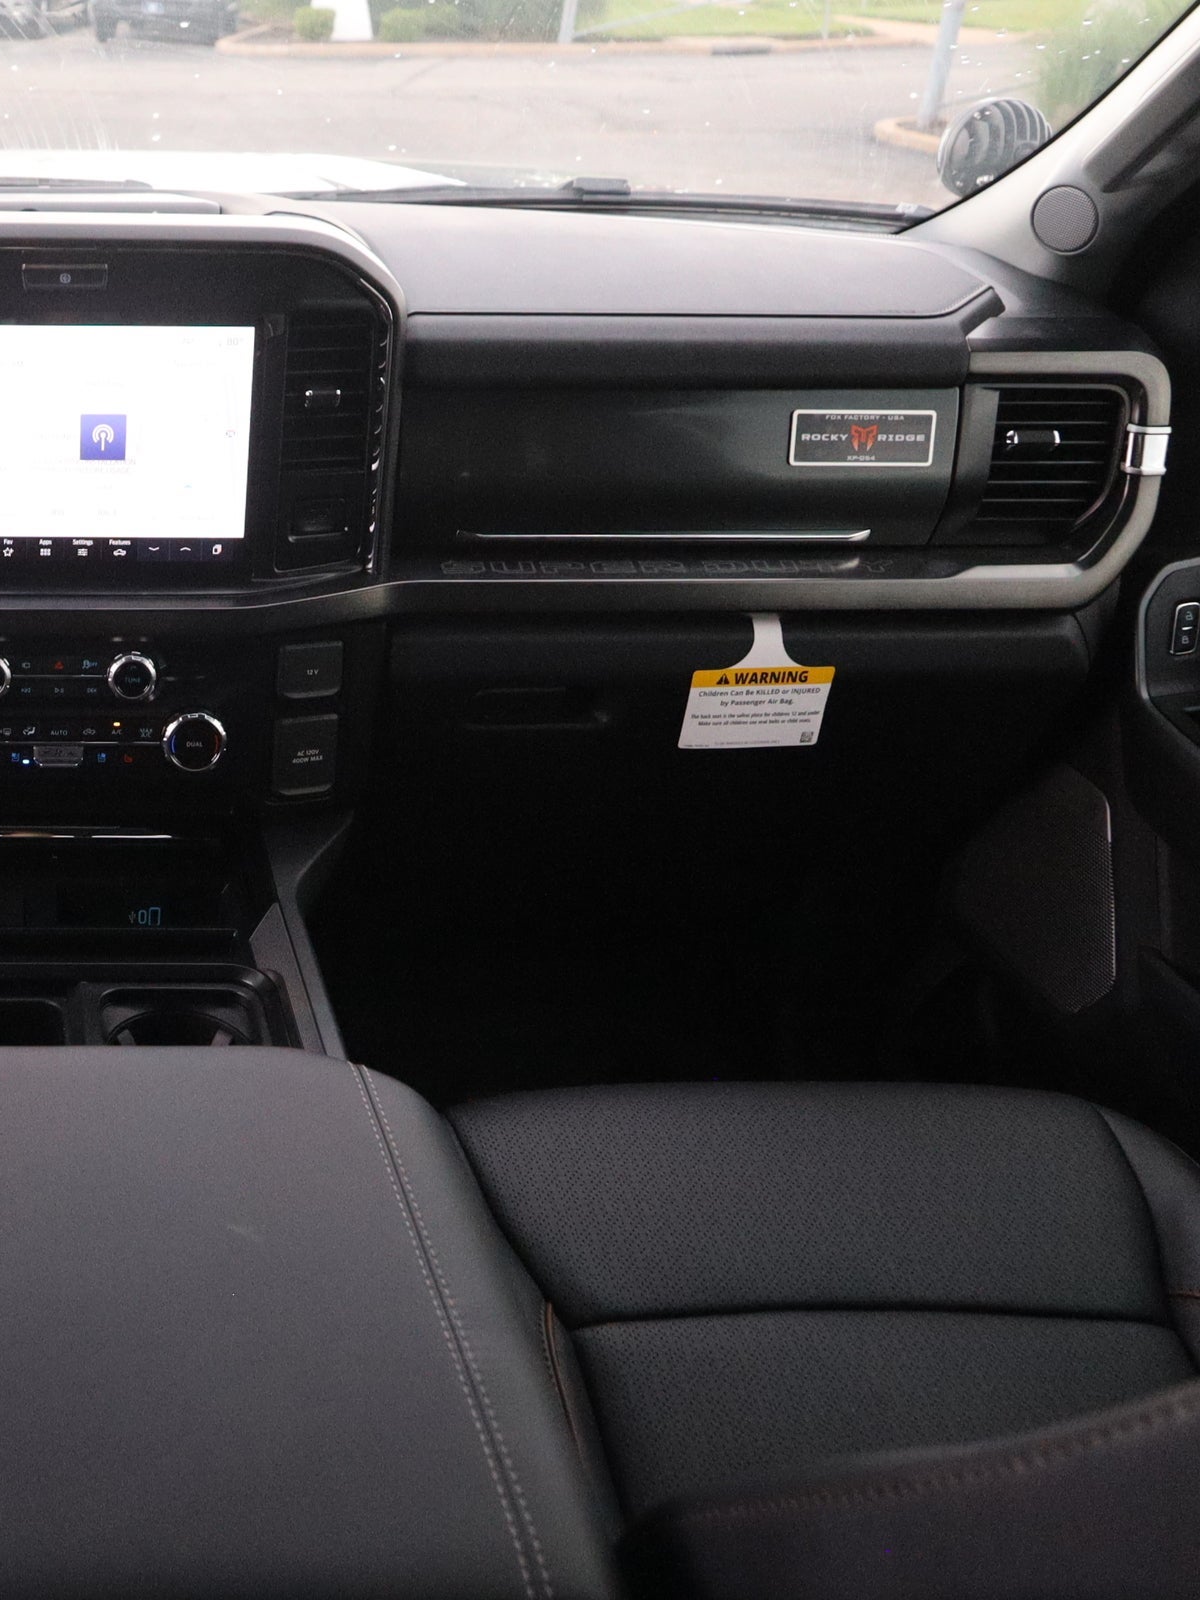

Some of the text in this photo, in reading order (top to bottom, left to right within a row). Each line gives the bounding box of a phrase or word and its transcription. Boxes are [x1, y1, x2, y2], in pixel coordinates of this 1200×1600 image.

[801, 433, 926, 442] ROCKY RIDGE
[734, 671, 809, 685] WARNING
[790, 687, 821, 695] INJURED
